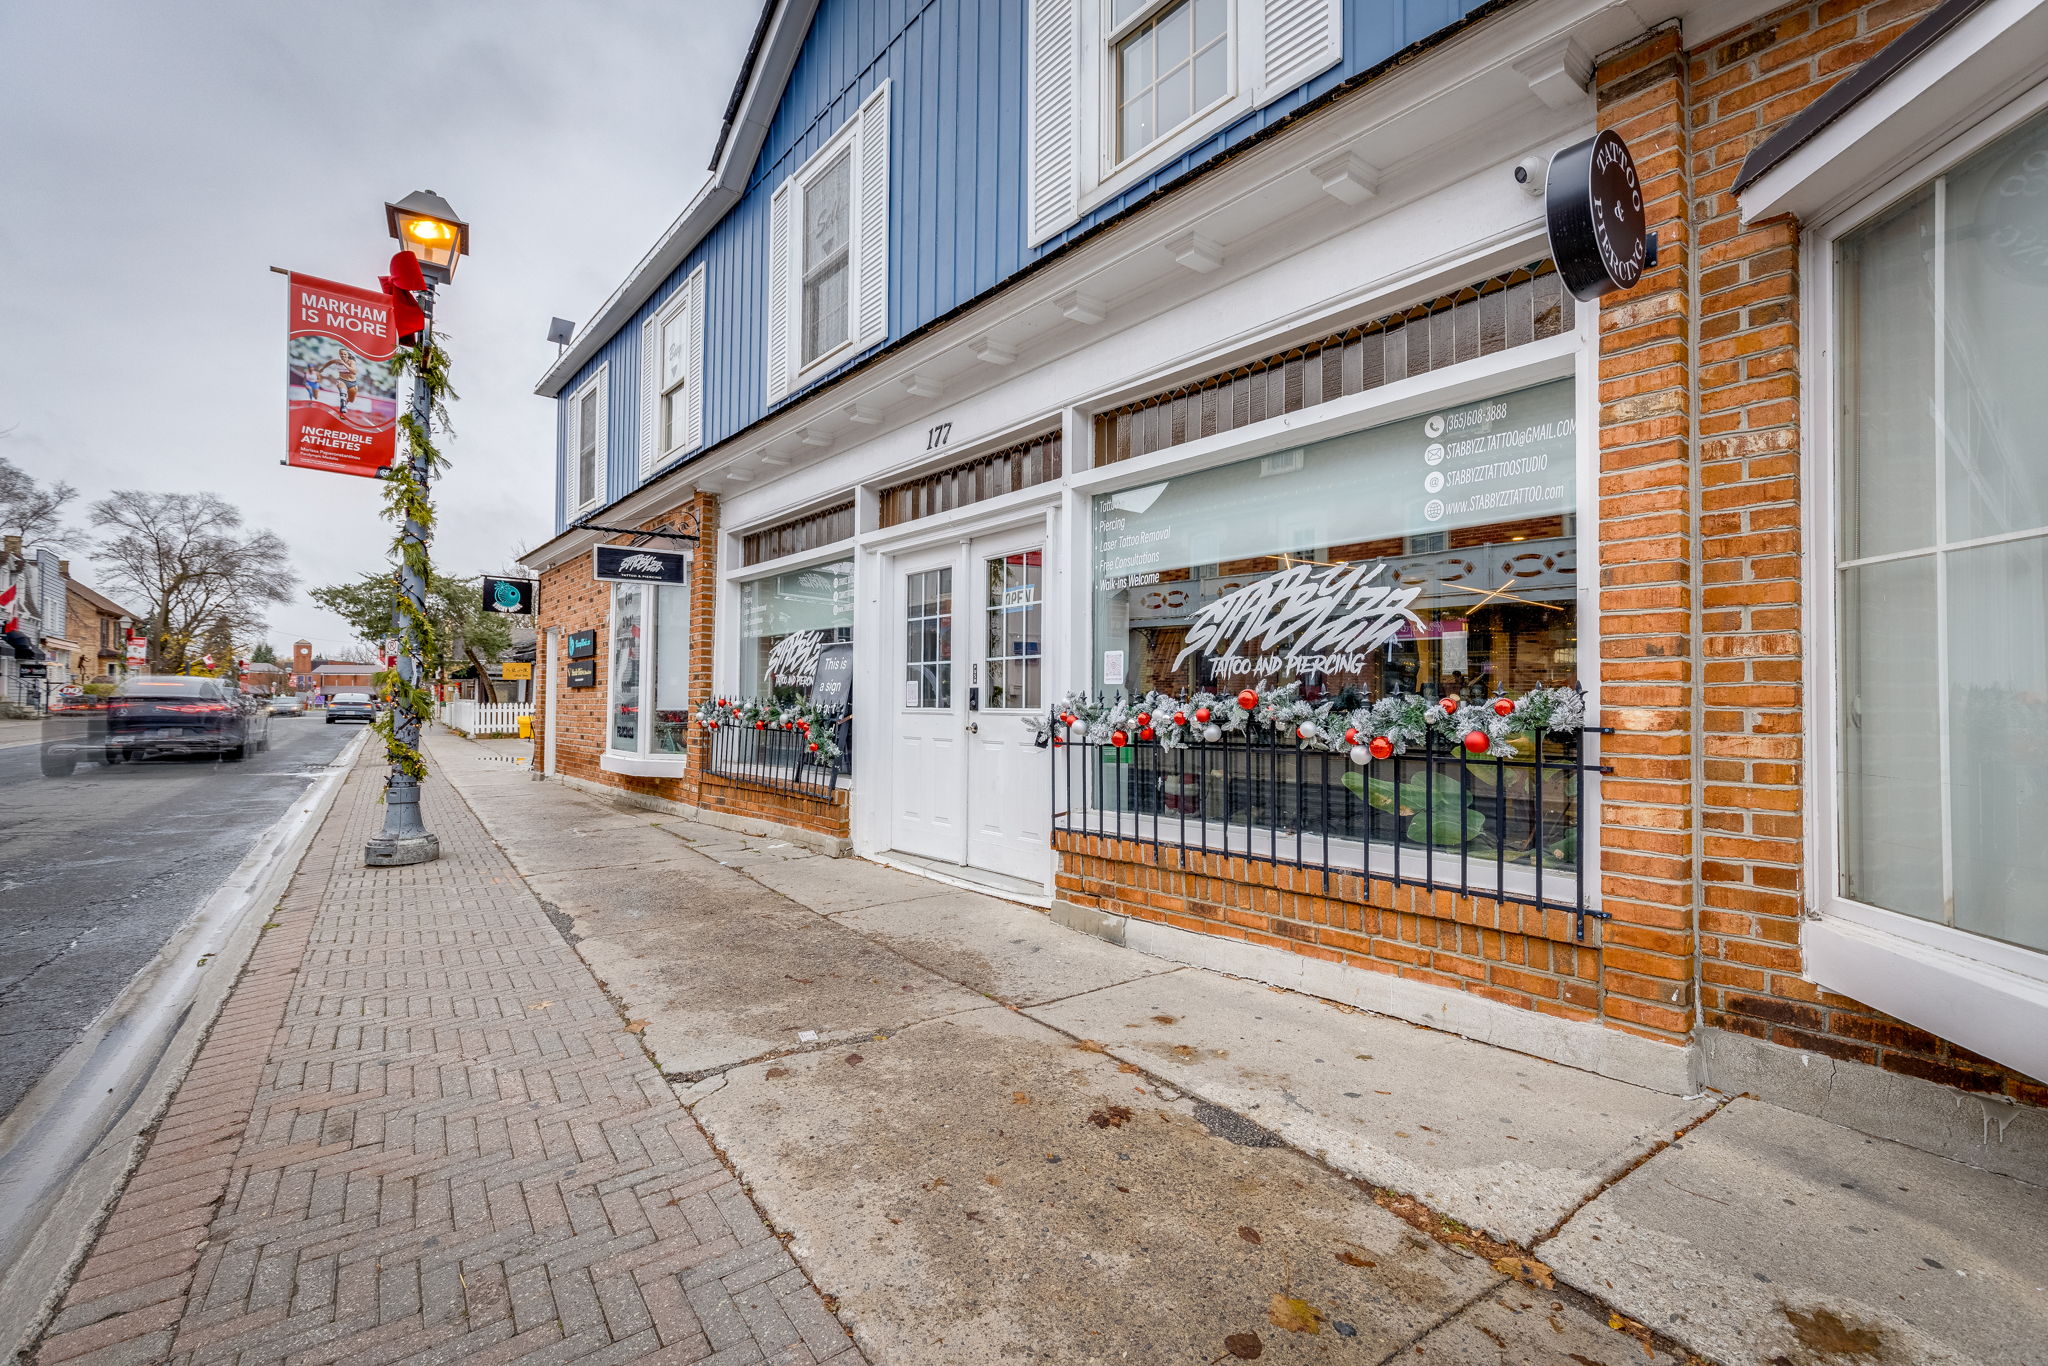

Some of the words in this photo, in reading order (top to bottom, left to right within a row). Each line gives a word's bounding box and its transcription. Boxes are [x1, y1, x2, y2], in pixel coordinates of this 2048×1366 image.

[1596, 141, 1641, 212] TATTOO
[1614, 200, 1625, 222] &
[1594, 196, 1644, 281] PIERCING
[301, 293, 387, 324] MARKHAM
[301, 307, 319, 323] IS
[327, 313, 387, 338] MORE
[1446, 403, 1507, 433] (365)608-3888
[301, 425, 373, 444] INCREDIBLE
[301, 435, 361, 451] ATHLETES
[926, 422, 953, 450] 177
[1099, 517, 1125, 532] Piercing
[1100, 540, 1117, 552] Laser
[1119, 535, 1139, 548] Tattoo
[1140, 525, 1171, 544] Removal
[1100, 560, 1114, 571] Free
[1115, 551, 1159, 569] Consultations
[1100, 577, 1127, 591] Walk-ins
[1128, 572, 1159, 587] Welcome
[825, 657, 840, 671] This
[840, 657, 847, 670] is
[1209, 656, 1251, 681] TATTOO
[1253, 652, 1282, 677] AND
[1284, 653, 1367, 681] PIERCING
[819, 682, 824, 691] a
[825, 679, 841, 695] sign
